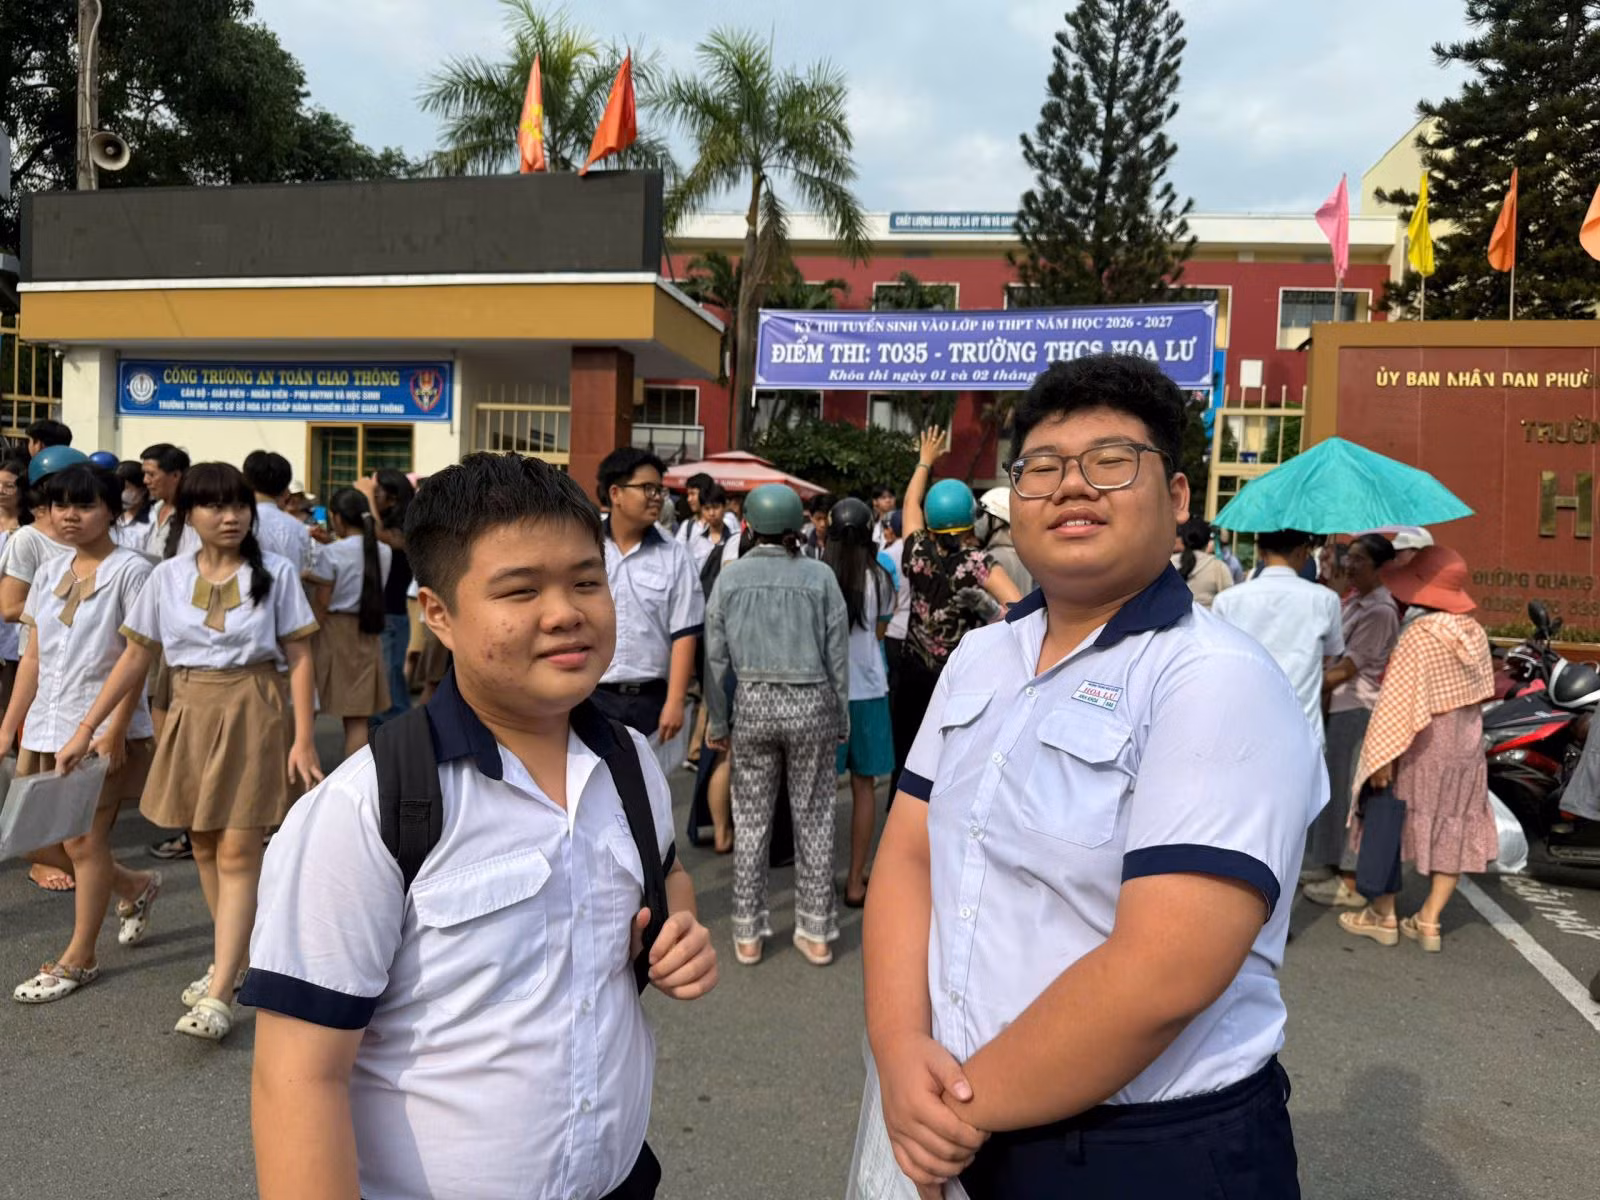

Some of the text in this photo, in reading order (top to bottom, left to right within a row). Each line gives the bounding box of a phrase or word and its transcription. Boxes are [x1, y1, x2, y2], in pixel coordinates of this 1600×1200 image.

[817, 320, 838, 333] THI
[886, 320, 917, 332] SINH
[921, 317, 949, 332] VÀO
[951, 317, 978, 331] LỚP
[982, 319, 995, 331] 10
[997, 319, 1034, 330] THPT
[1036, 316, 1068, 330] NĂM
[1071, 317, 1103, 331] HỌC
[1105, 316, 1134, 329] 2026
[1144, 315, 1173, 328] 2027
[771, 335, 824, 363] ĐIỂM
[830, 342, 871, 363] THI:
[878, 342, 928, 363] T035
[948, 335, 1037, 363] TRƯỜNG
[1044, 339, 1103, 362] THCS
[1165, 335, 1197, 362] LƯ
[256, 369, 274, 385] AN
[317, 369, 349, 386] GIAO
[353, 367, 400, 386] THÔNG
[828, 368, 1037, 383] Khóa thi ngày 01 và 02 tháng
[1376, 366, 1400, 386] ỦY
[1406, 371, 1440, 387] BAN
[1447, 368, 1495, 387] NHÂN
